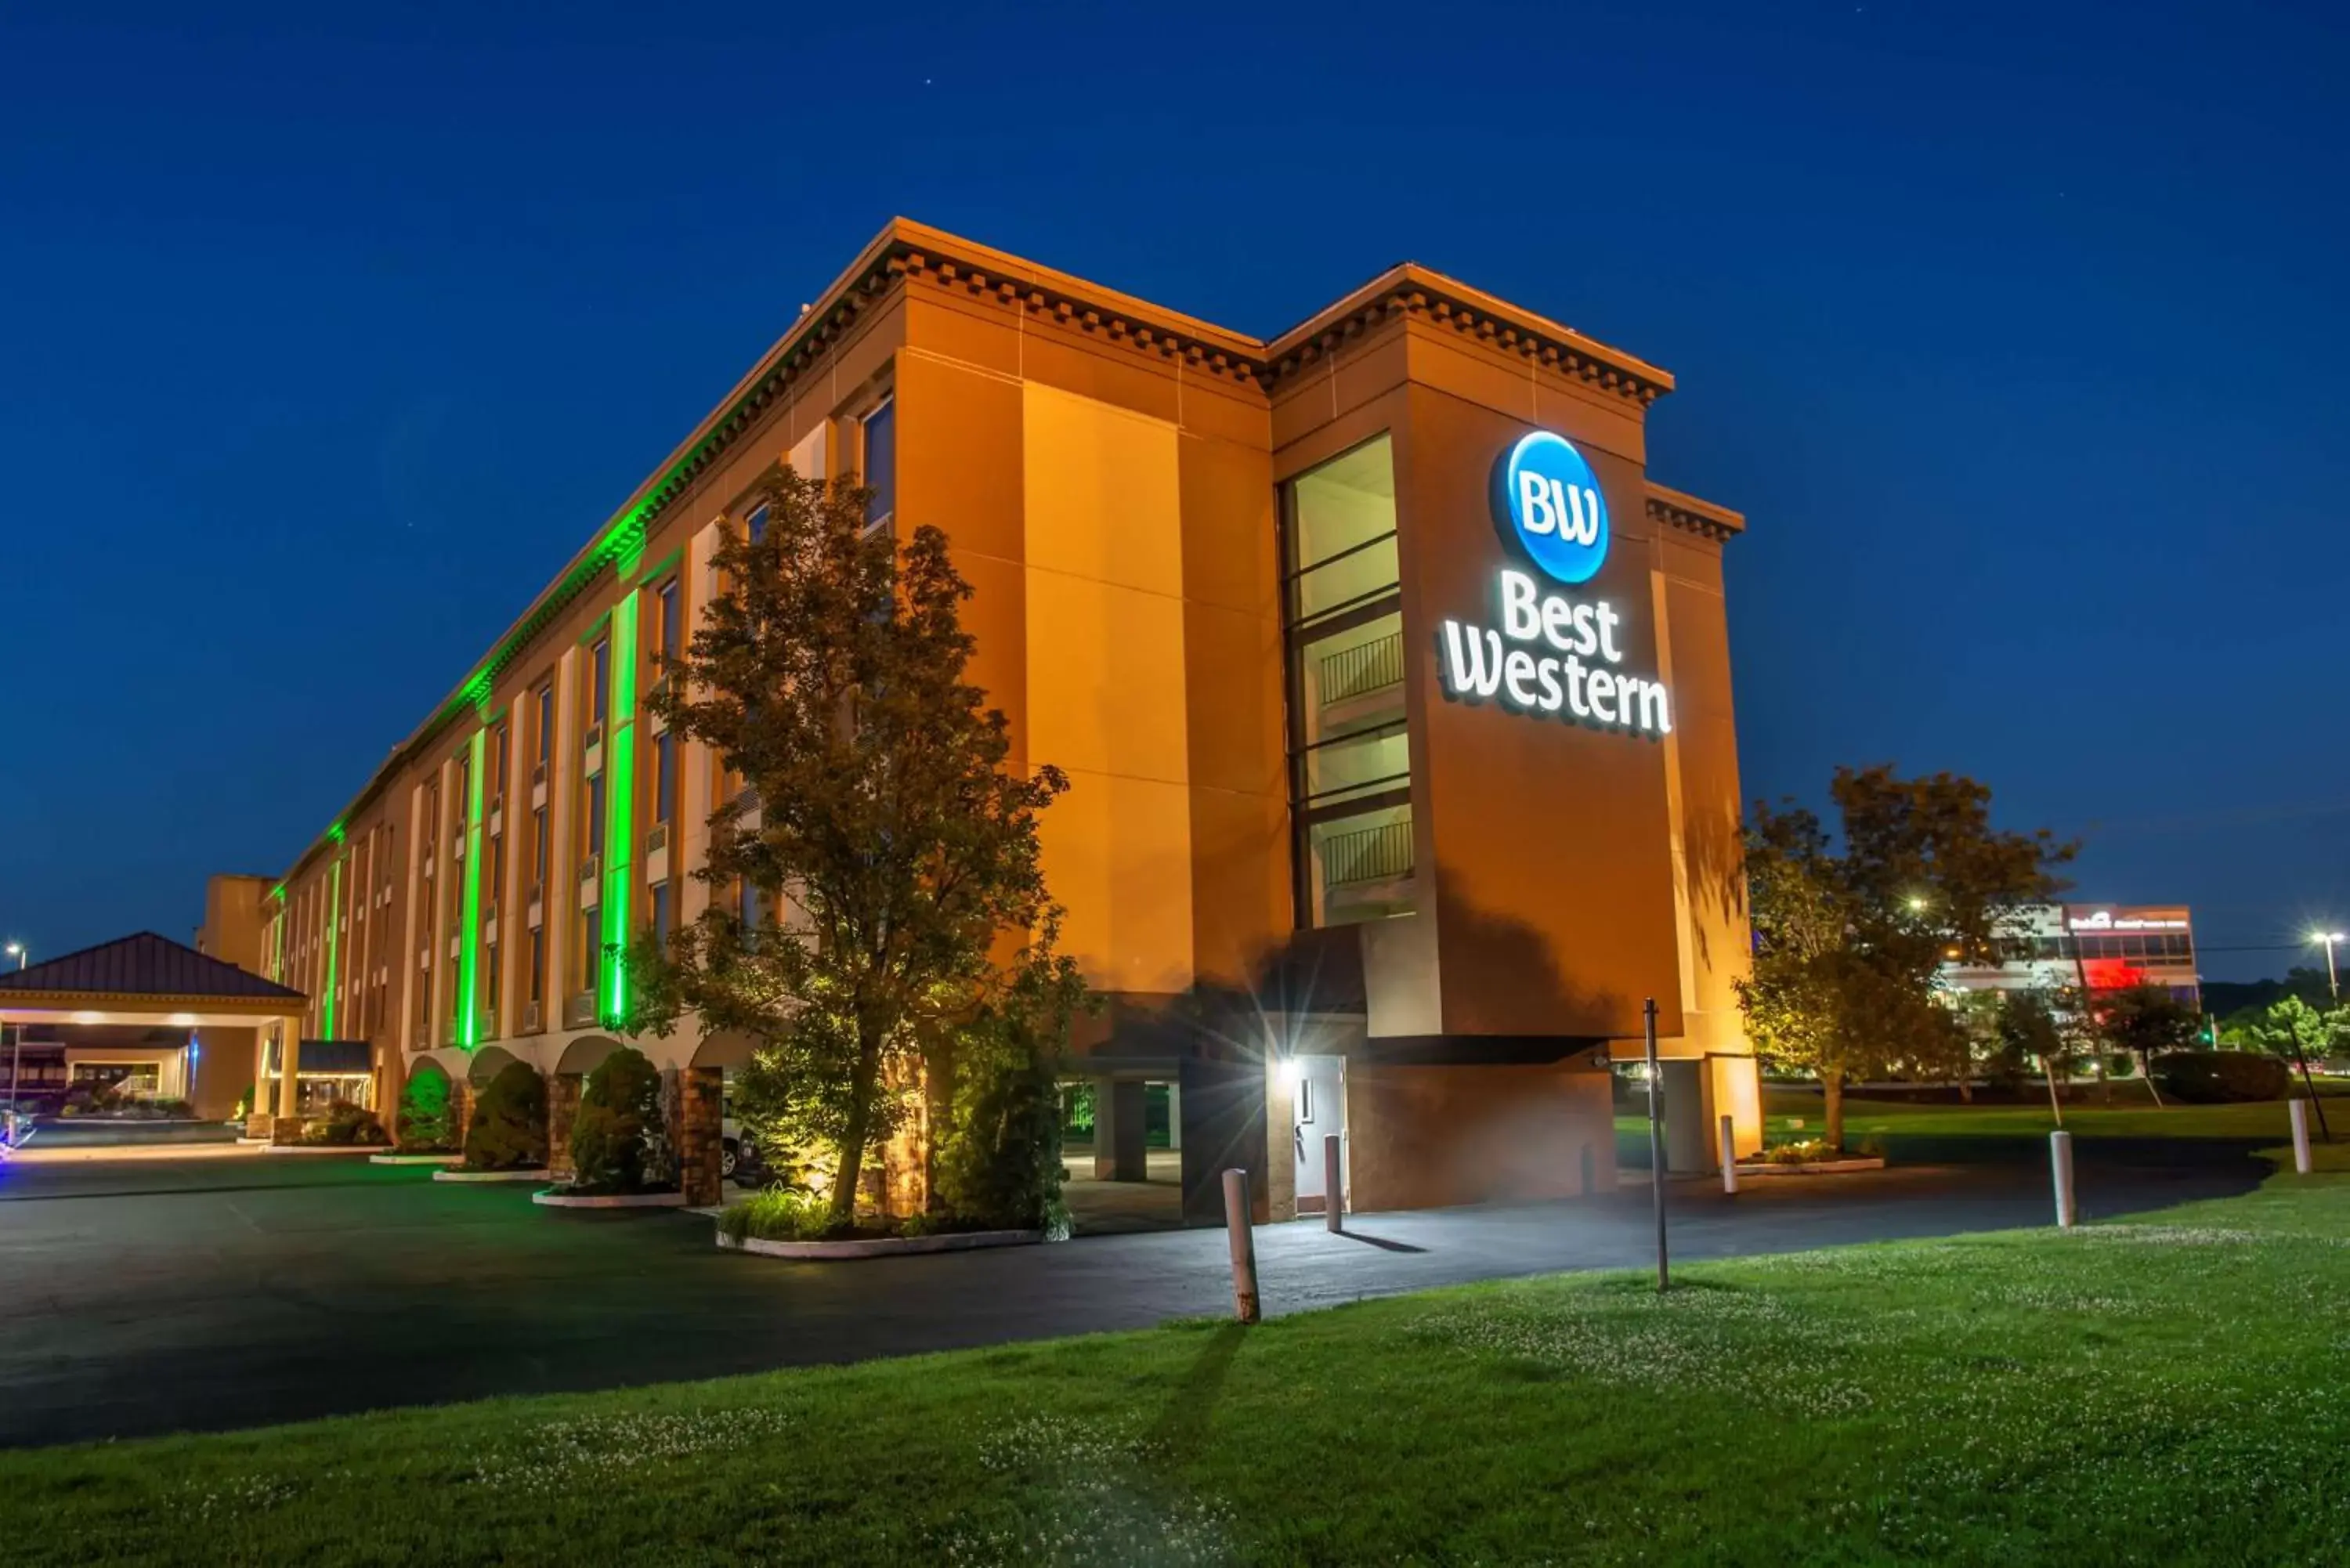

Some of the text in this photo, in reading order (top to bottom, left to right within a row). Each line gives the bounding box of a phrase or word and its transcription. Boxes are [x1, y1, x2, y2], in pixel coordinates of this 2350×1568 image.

[1518, 470, 1599, 546] BW
[1501, 569, 1622, 663] Best
[1444, 620, 1672, 733] Western
